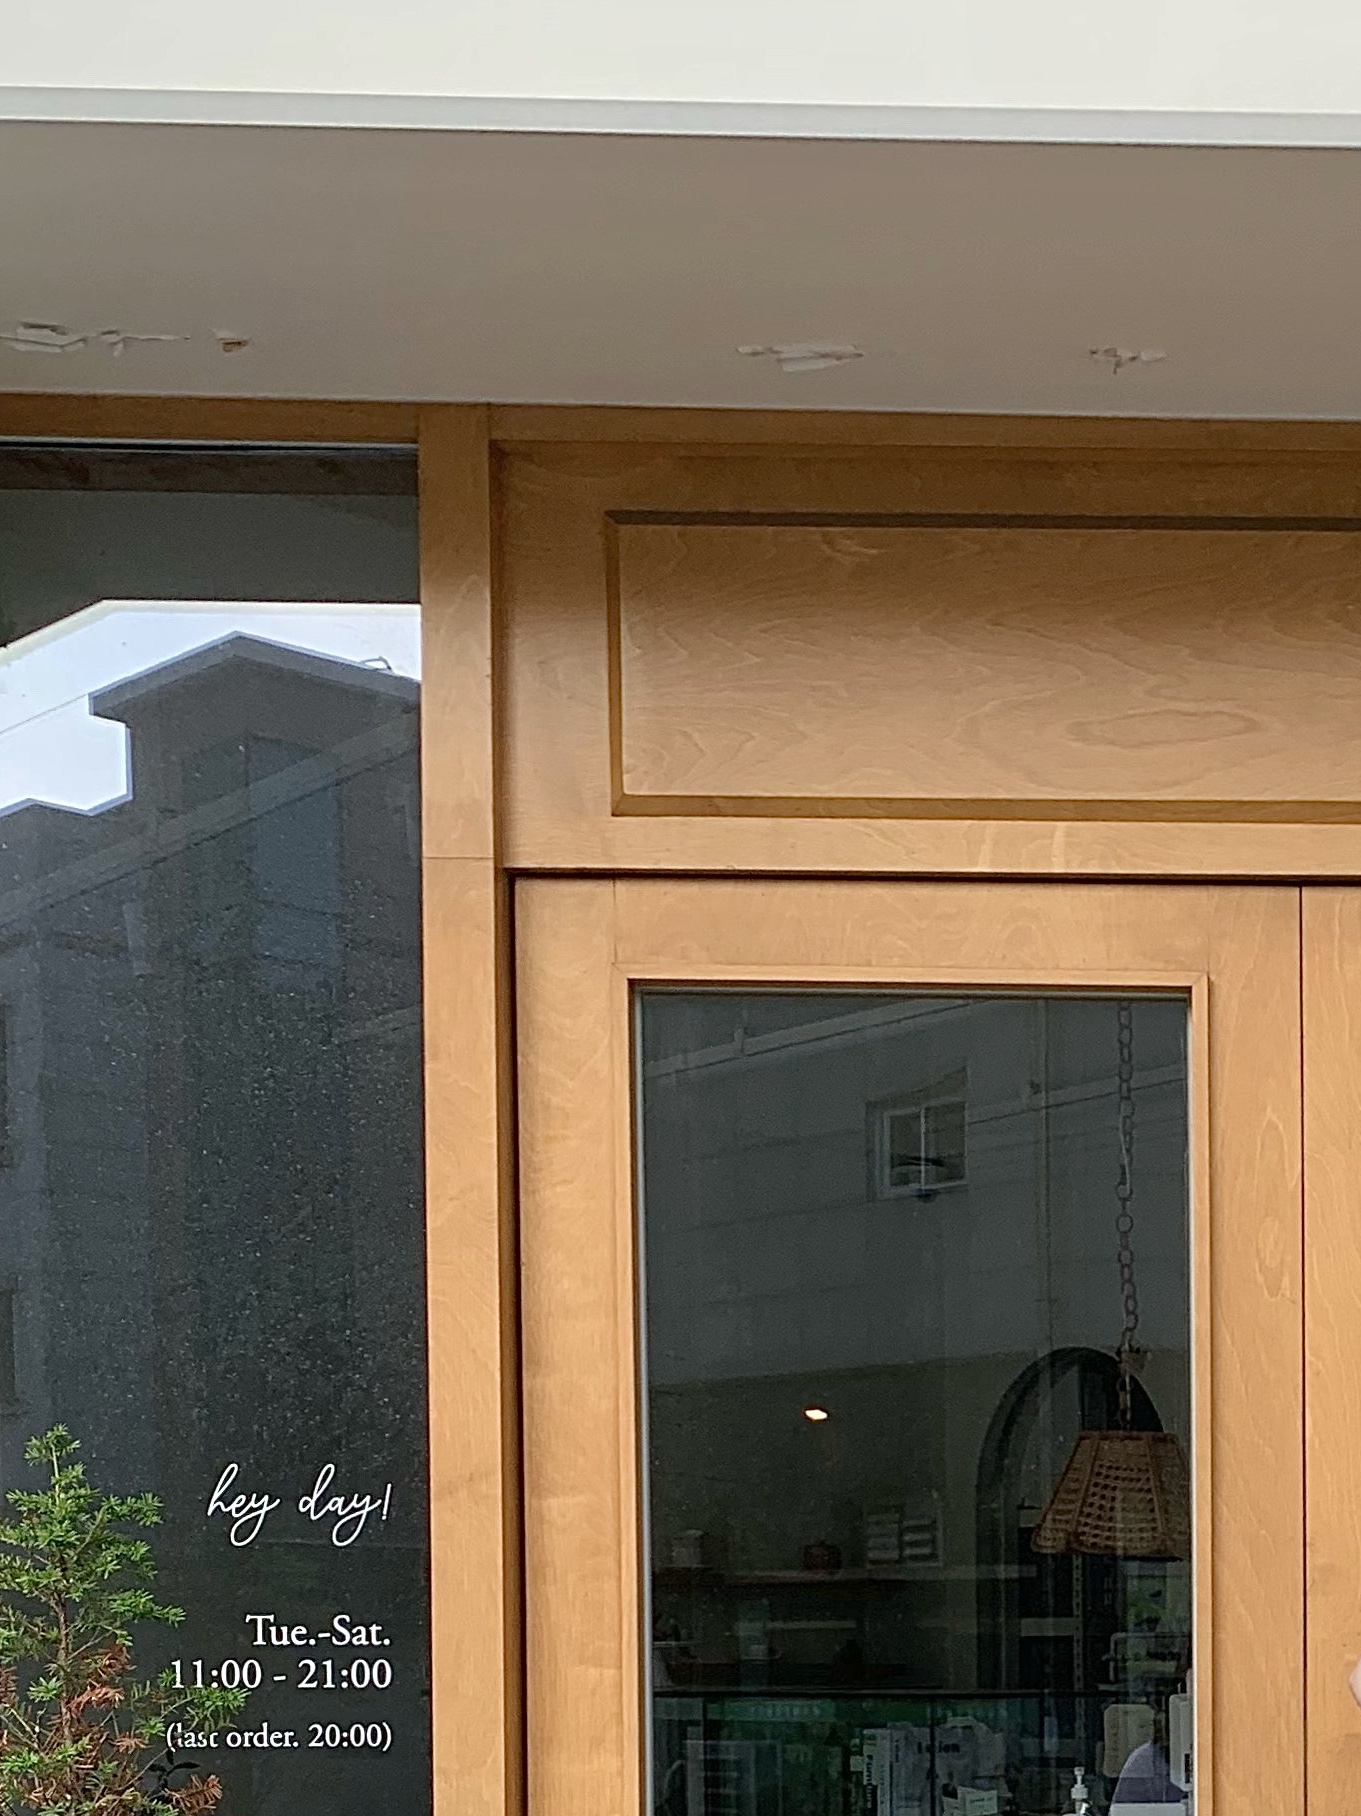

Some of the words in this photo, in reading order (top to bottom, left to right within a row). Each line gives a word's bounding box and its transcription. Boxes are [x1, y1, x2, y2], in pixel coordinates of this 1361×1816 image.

[207, 1463, 281, 1547] hey
[298, 1463, 392, 1547] day!
[245, 1614, 391, 1646] Tue.-Sat.
[171, 1659, 262, 1689] 11:00
[297, 1659, 392, 1689] 21:00
[166, 1722, 219, 1752] (last
[226, 1723, 299, 1747] order.
[308, 1722, 391, 1752] 20:00)
